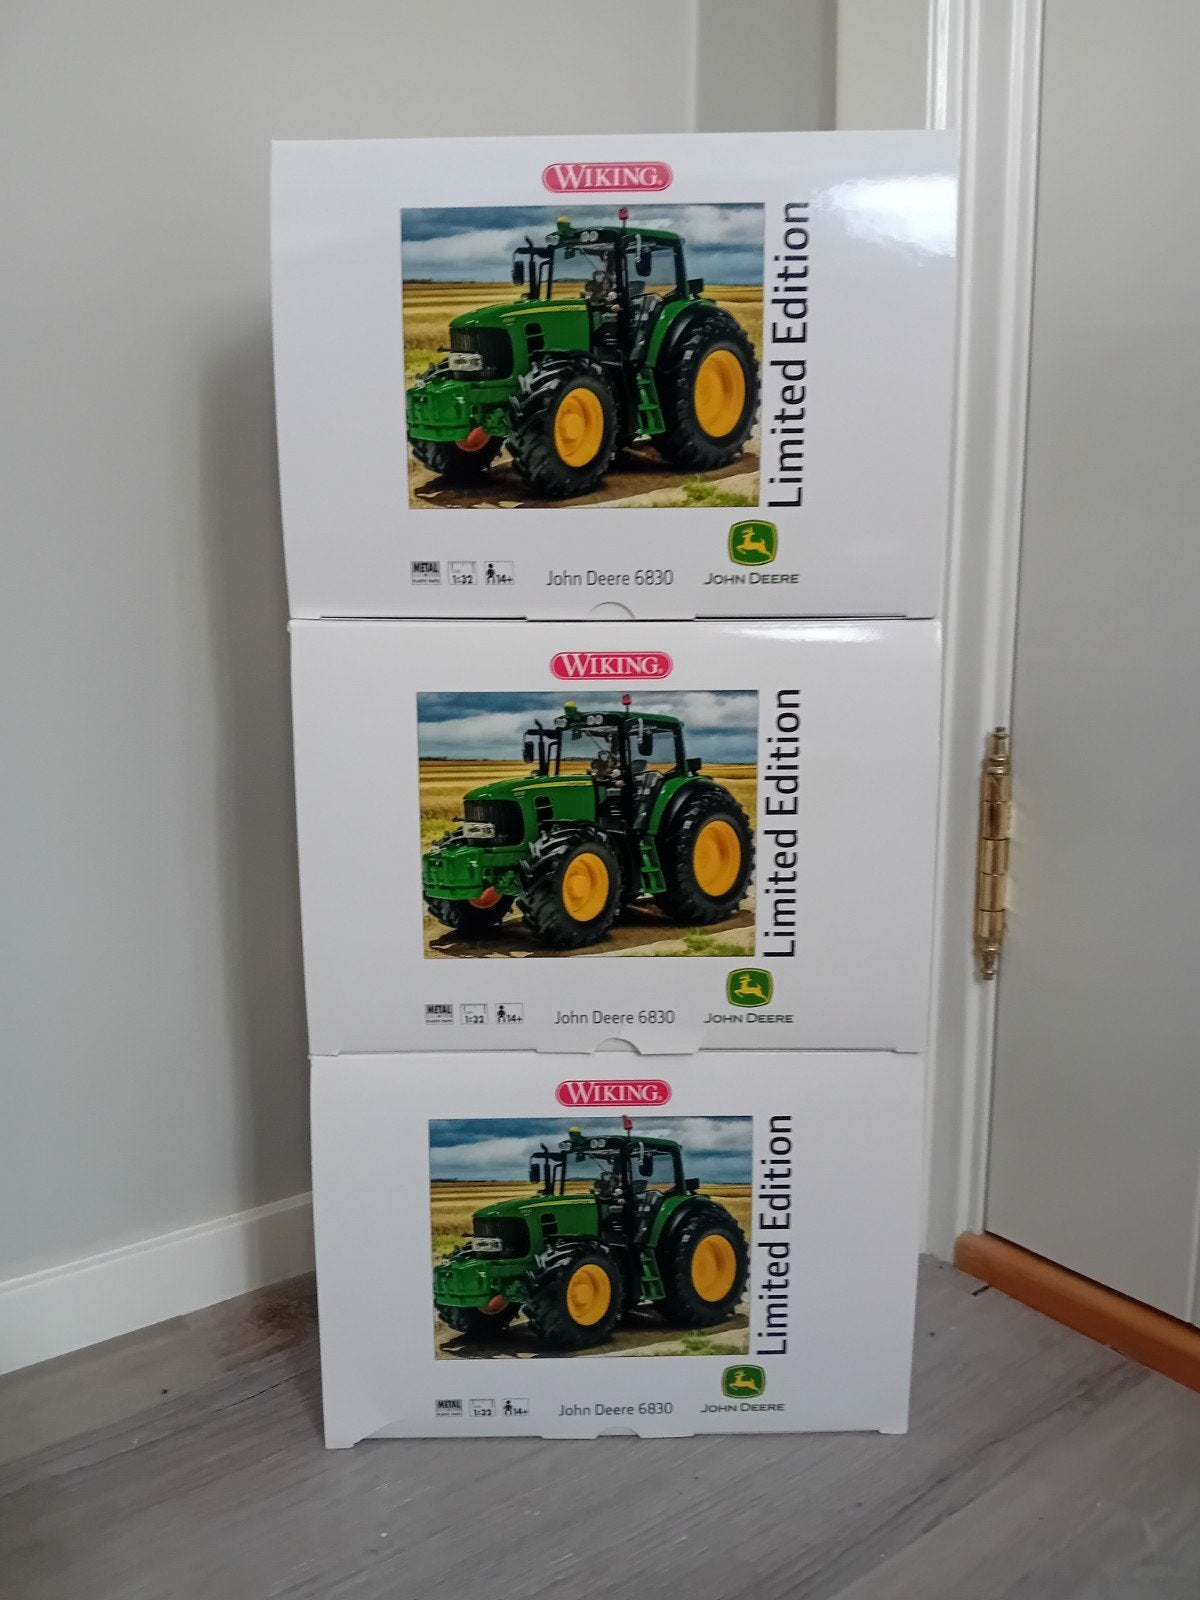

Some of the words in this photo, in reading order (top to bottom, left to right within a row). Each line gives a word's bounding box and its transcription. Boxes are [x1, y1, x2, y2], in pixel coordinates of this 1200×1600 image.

[770, 202, 808, 343] Edition
[768, 360, 806, 508] Limited
[546, 569, 582, 586] John
[586, 569, 630, 586] Deere
[634, 569, 674, 586] 6830
[703, 572, 745, 585] JOHN
[749, 571, 799, 585] DEERE
[765, 690, 800, 815] Edition
[763, 830, 798, 957] Limited
[554, 1010, 588, 1025] John
[592, 1010, 634, 1025] Deere
[638, 1010, 676, 1025] 6830
[704, 1012, 743, 1024] JOHN
[746, 1012, 794, 1024] DEERE
[759, 1116, 792, 1230] Edition
[757, 1243, 790, 1355] Limited
[558, 1404, 591, 1417] John
[595, 1403, 635, 1416] Deere
[638, 1402, 673, 1415] 6830
[700, 1403, 737, 1413] JOHN
[741, 1402, 785, 1413] DEERE
